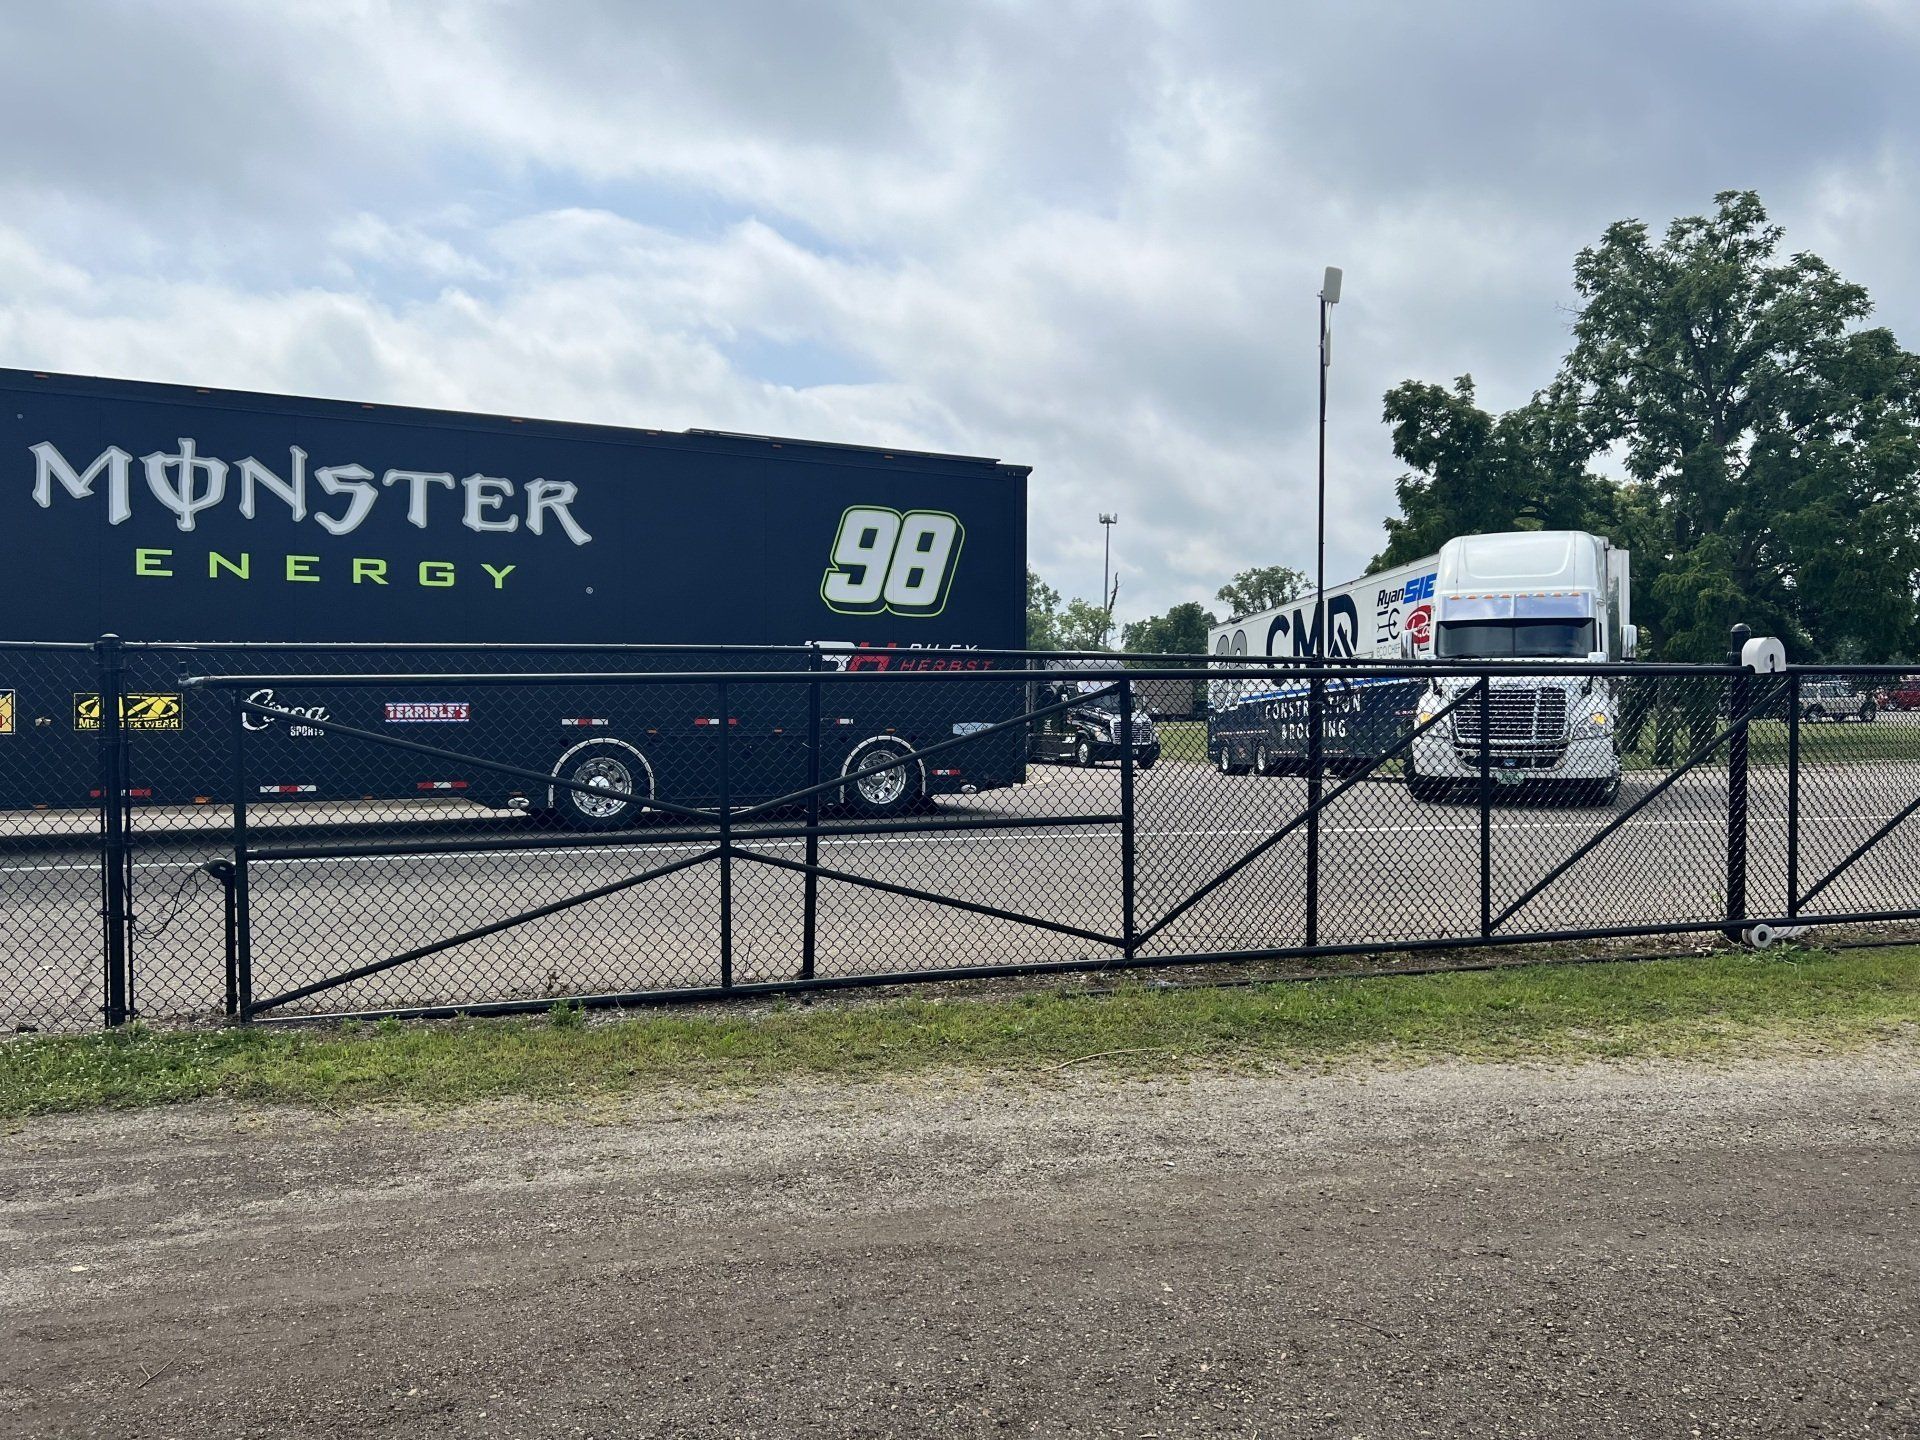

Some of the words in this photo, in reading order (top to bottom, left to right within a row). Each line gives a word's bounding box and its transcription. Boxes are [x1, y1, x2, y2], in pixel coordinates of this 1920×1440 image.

[28, 437, 592, 546] MONSTER
[135, 548, 516, 589] ENERGY
[820, 505, 965, 617] 98
[901, 659, 993, 672] HERBST
[143, 719, 179, 729] WEAR
[387, 706, 468, 718] TERRIBLE'S
